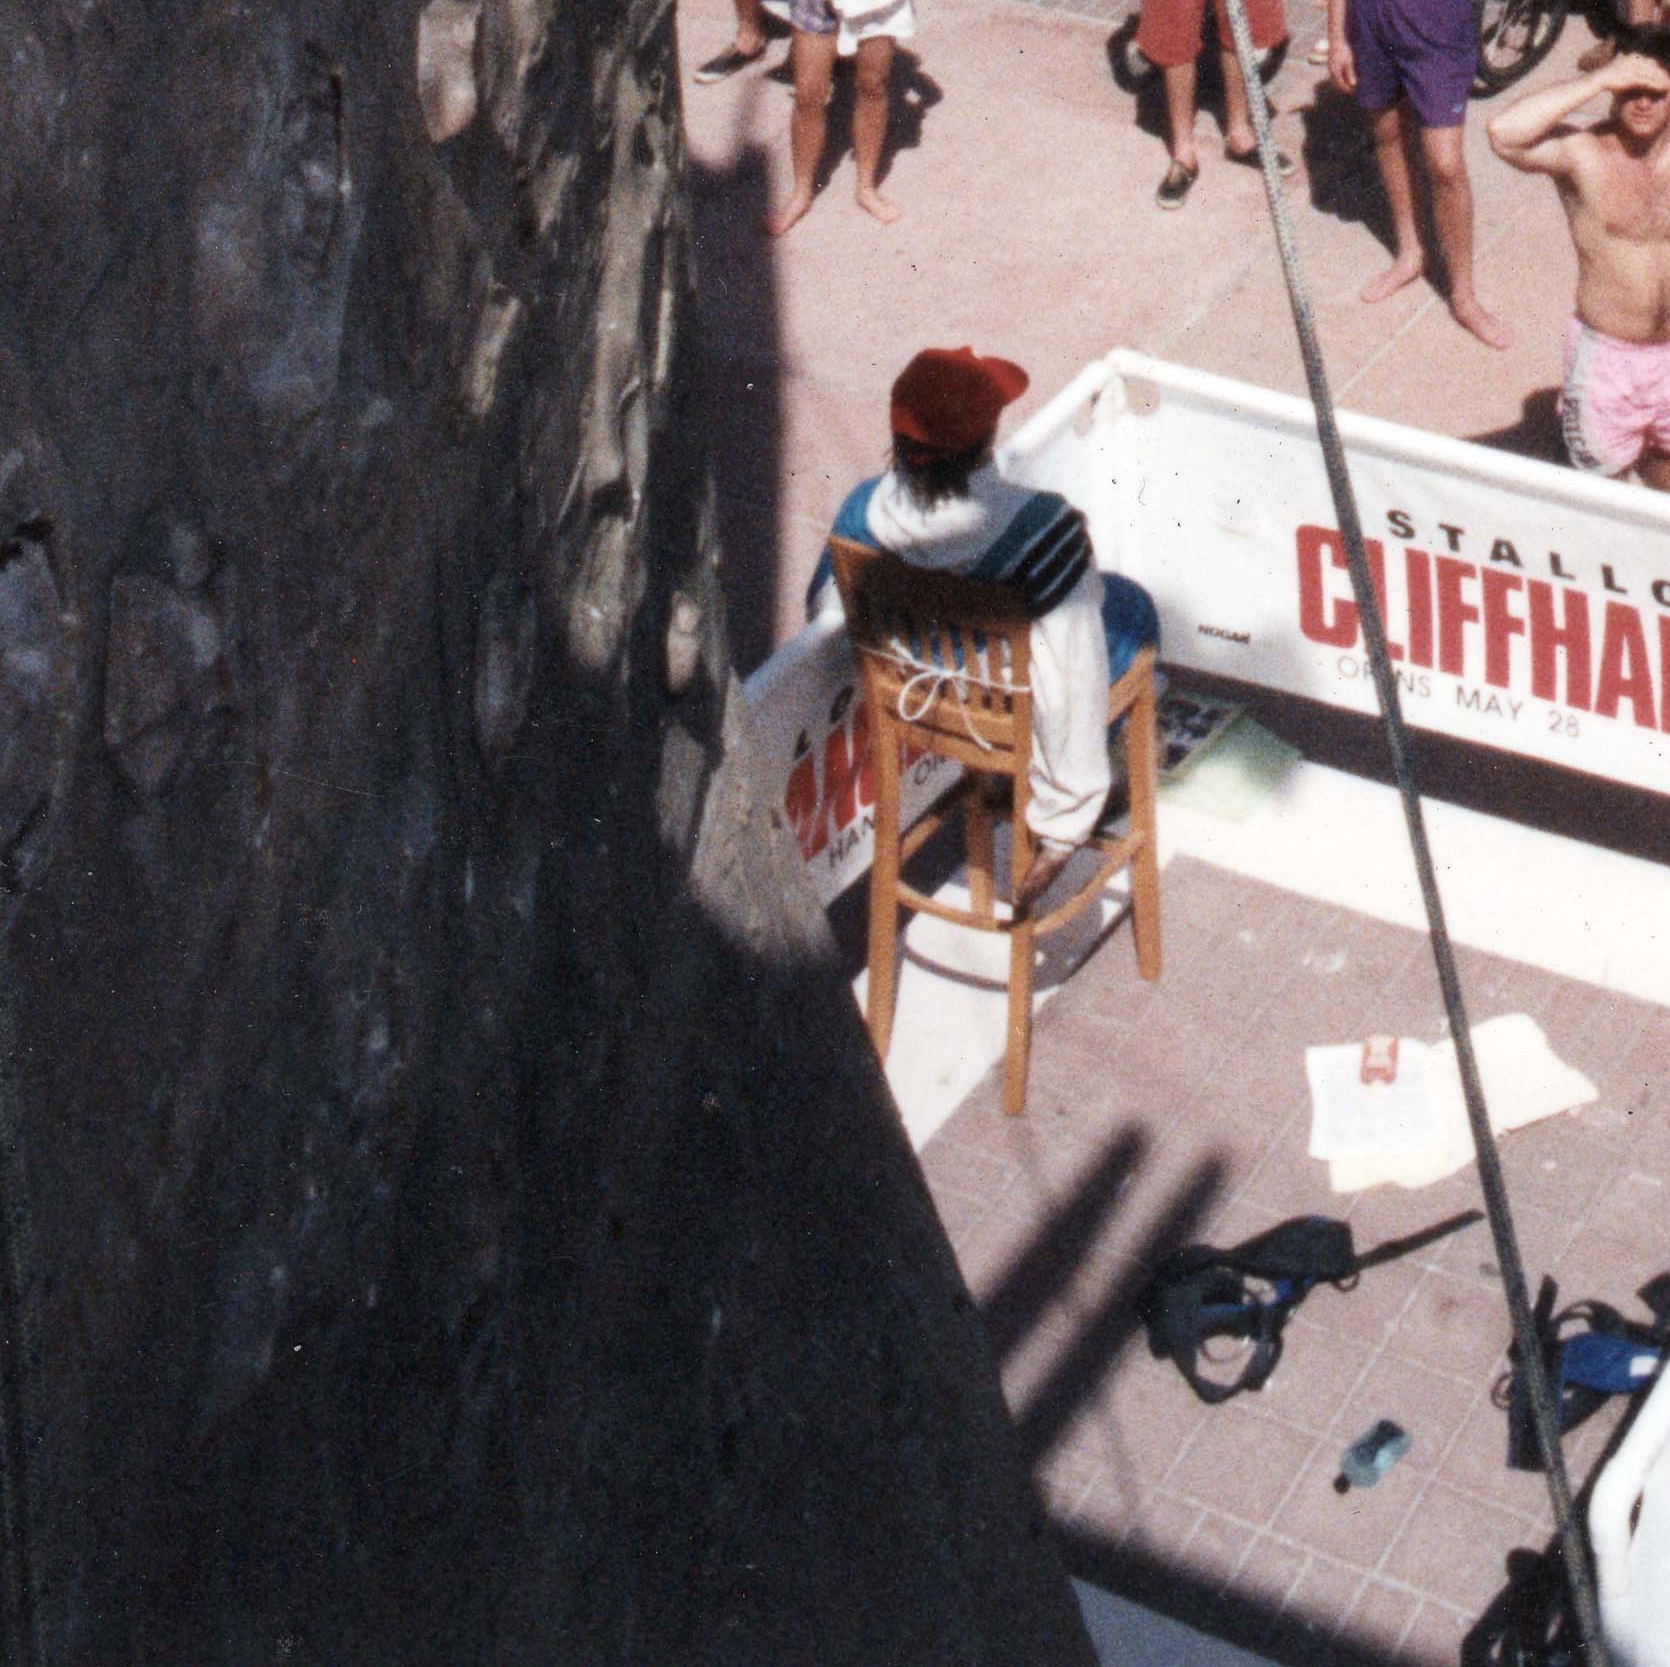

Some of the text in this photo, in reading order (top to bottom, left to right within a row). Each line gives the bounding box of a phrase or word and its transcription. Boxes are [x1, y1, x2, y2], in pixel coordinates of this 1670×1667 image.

[1337, 655, 1580, 738] OPNS MAY 28
[829, 816, 876, 867] HAN
